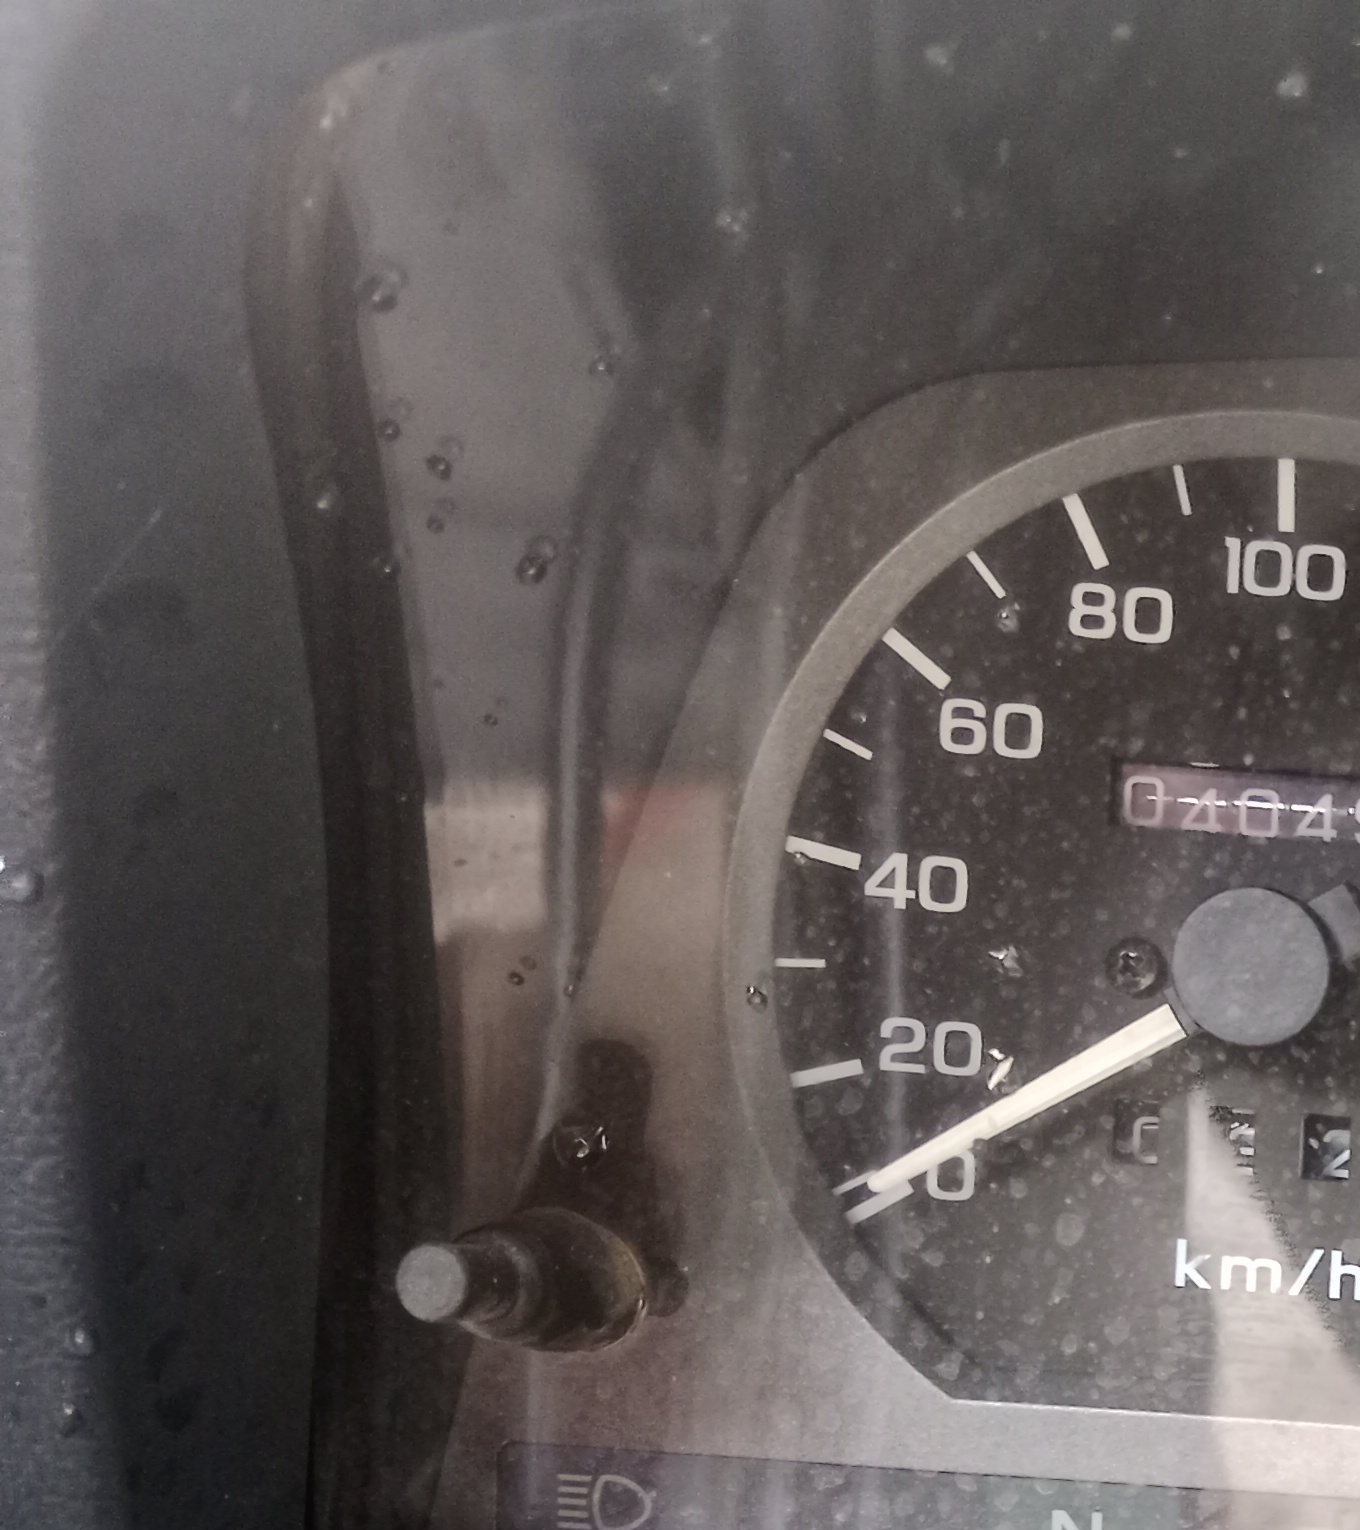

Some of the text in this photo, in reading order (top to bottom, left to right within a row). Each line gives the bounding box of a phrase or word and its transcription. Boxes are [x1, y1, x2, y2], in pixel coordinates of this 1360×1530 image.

[1224, 537, 1346, 602] 100
[1067, 582, 1174, 644] 80
[938, 698, 1043, 759] 60
[864, 854, 969, 913] 40
[878, 1016, 984, 1079] 20
[925, 1148, 976, 1202] 0
